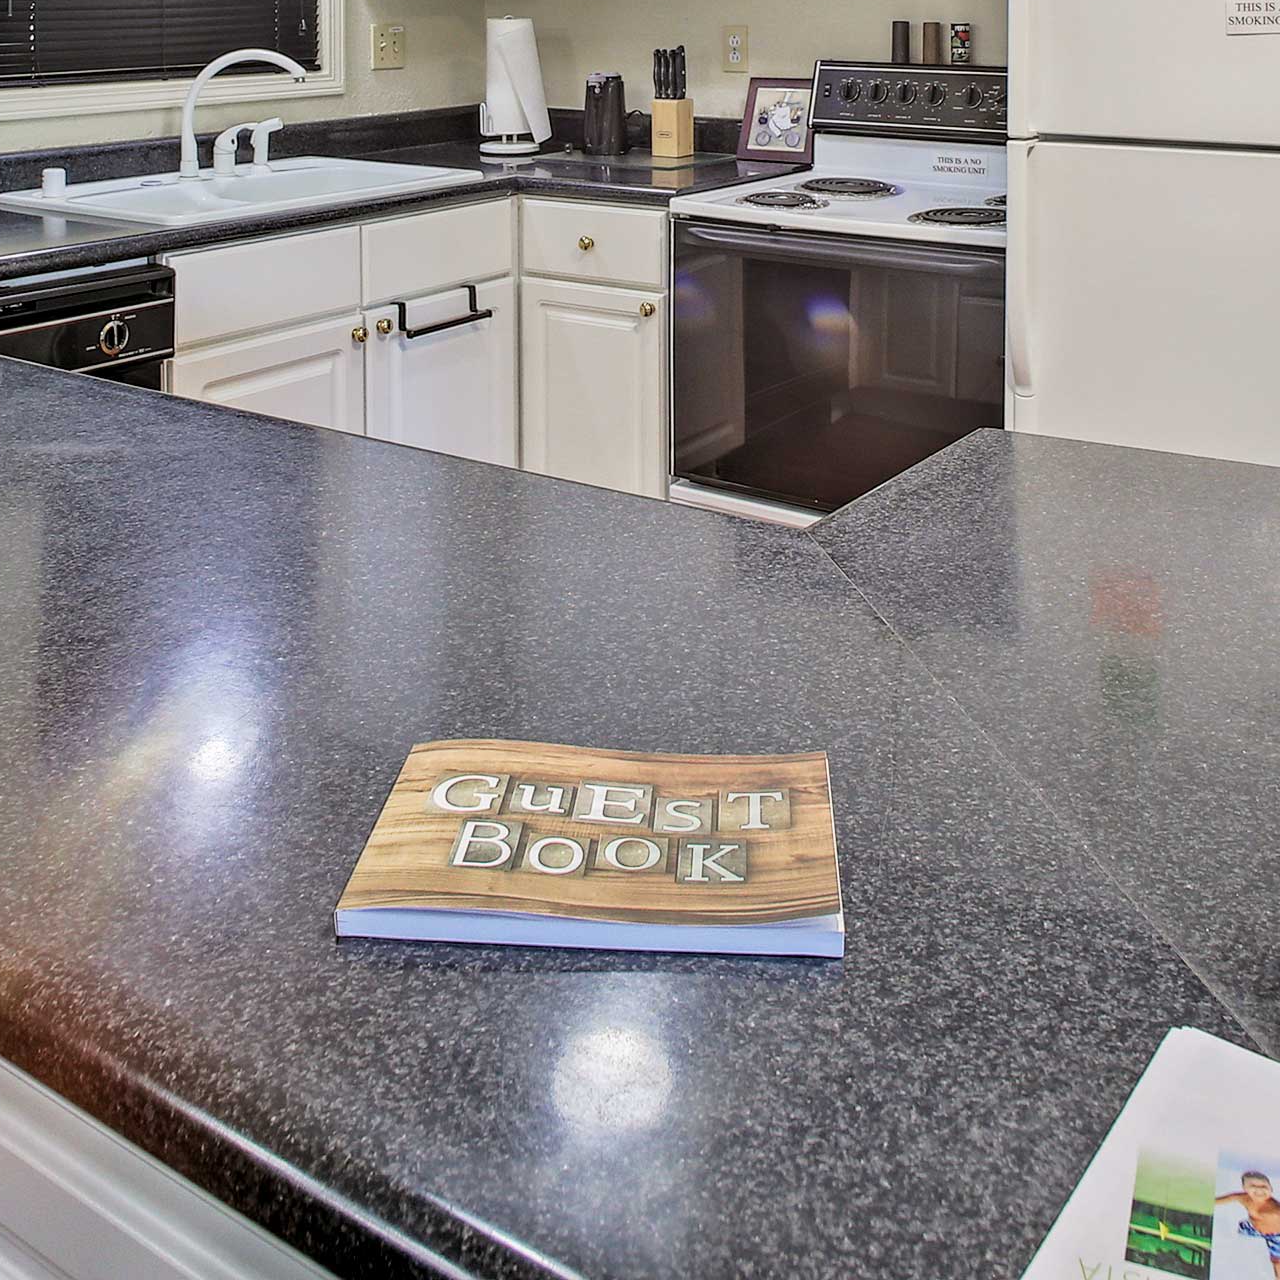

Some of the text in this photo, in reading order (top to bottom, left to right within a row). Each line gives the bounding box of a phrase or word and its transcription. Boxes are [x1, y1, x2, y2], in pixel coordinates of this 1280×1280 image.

[1235, 2, 1262, 12] THIS
[1265, 2, 1275, 12] IS
[937, 156, 953, 164] THIS
[954, 157, 962, 165] IS
[970, 158, 982, 166] NO
[932, 165, 986, 175] SMOKING UNIT
[452, 820, 745, 883] BOOK
